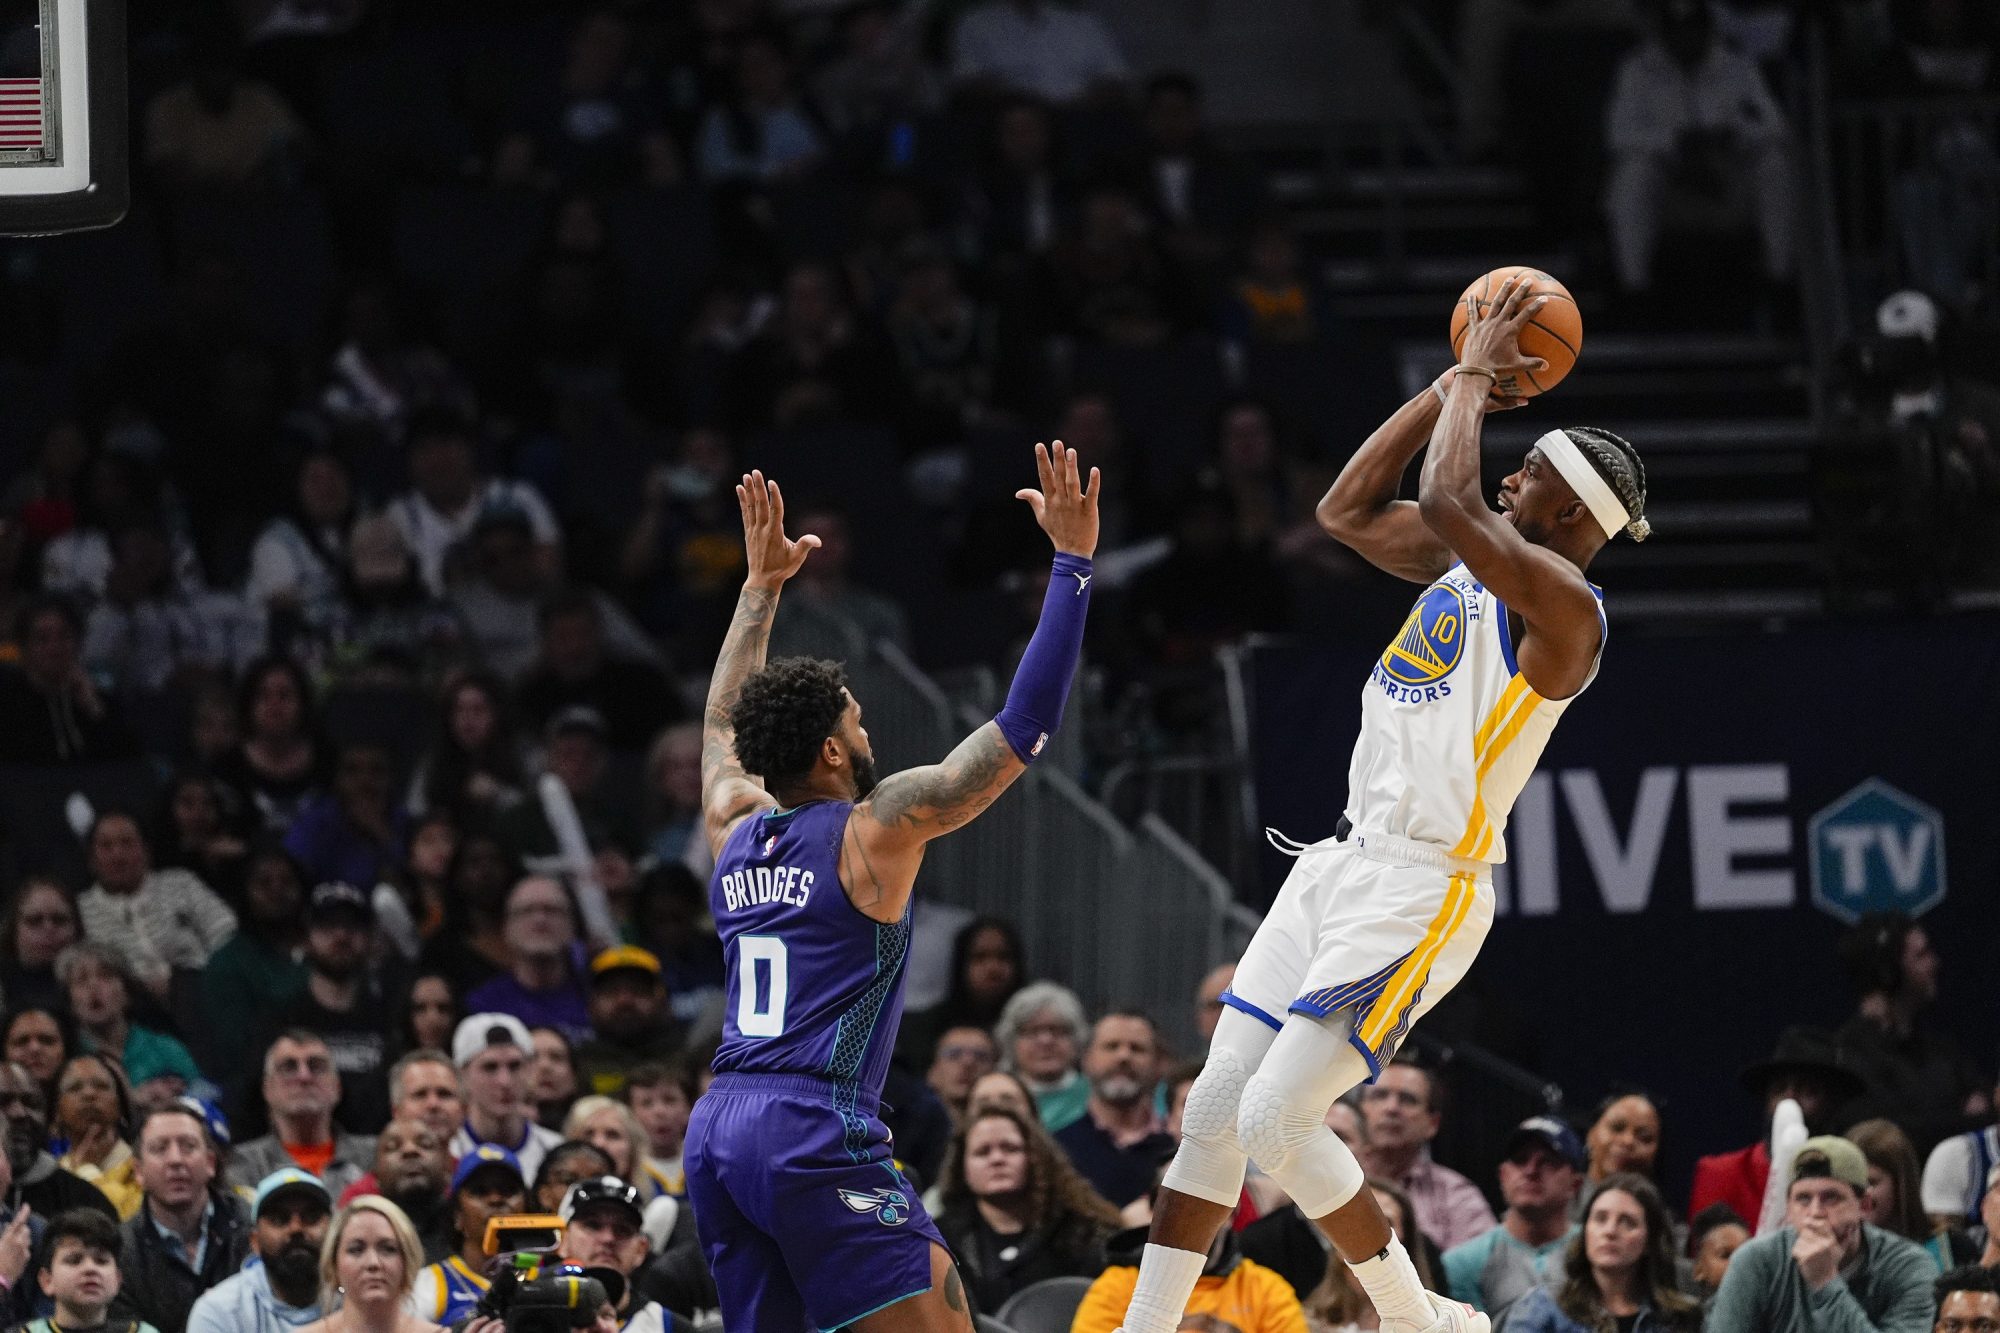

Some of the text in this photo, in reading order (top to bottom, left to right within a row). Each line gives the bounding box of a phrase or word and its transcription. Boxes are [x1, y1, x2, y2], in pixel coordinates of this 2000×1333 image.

[1430, 611, 1457, 644] 10
[1372, 665, 1452, 704] ARRIORS
[1493, 763, 1930, 916] IVE TV
[721, 866, 815, 913] BRIDGES
[737, 935, 788, 1037] 0
